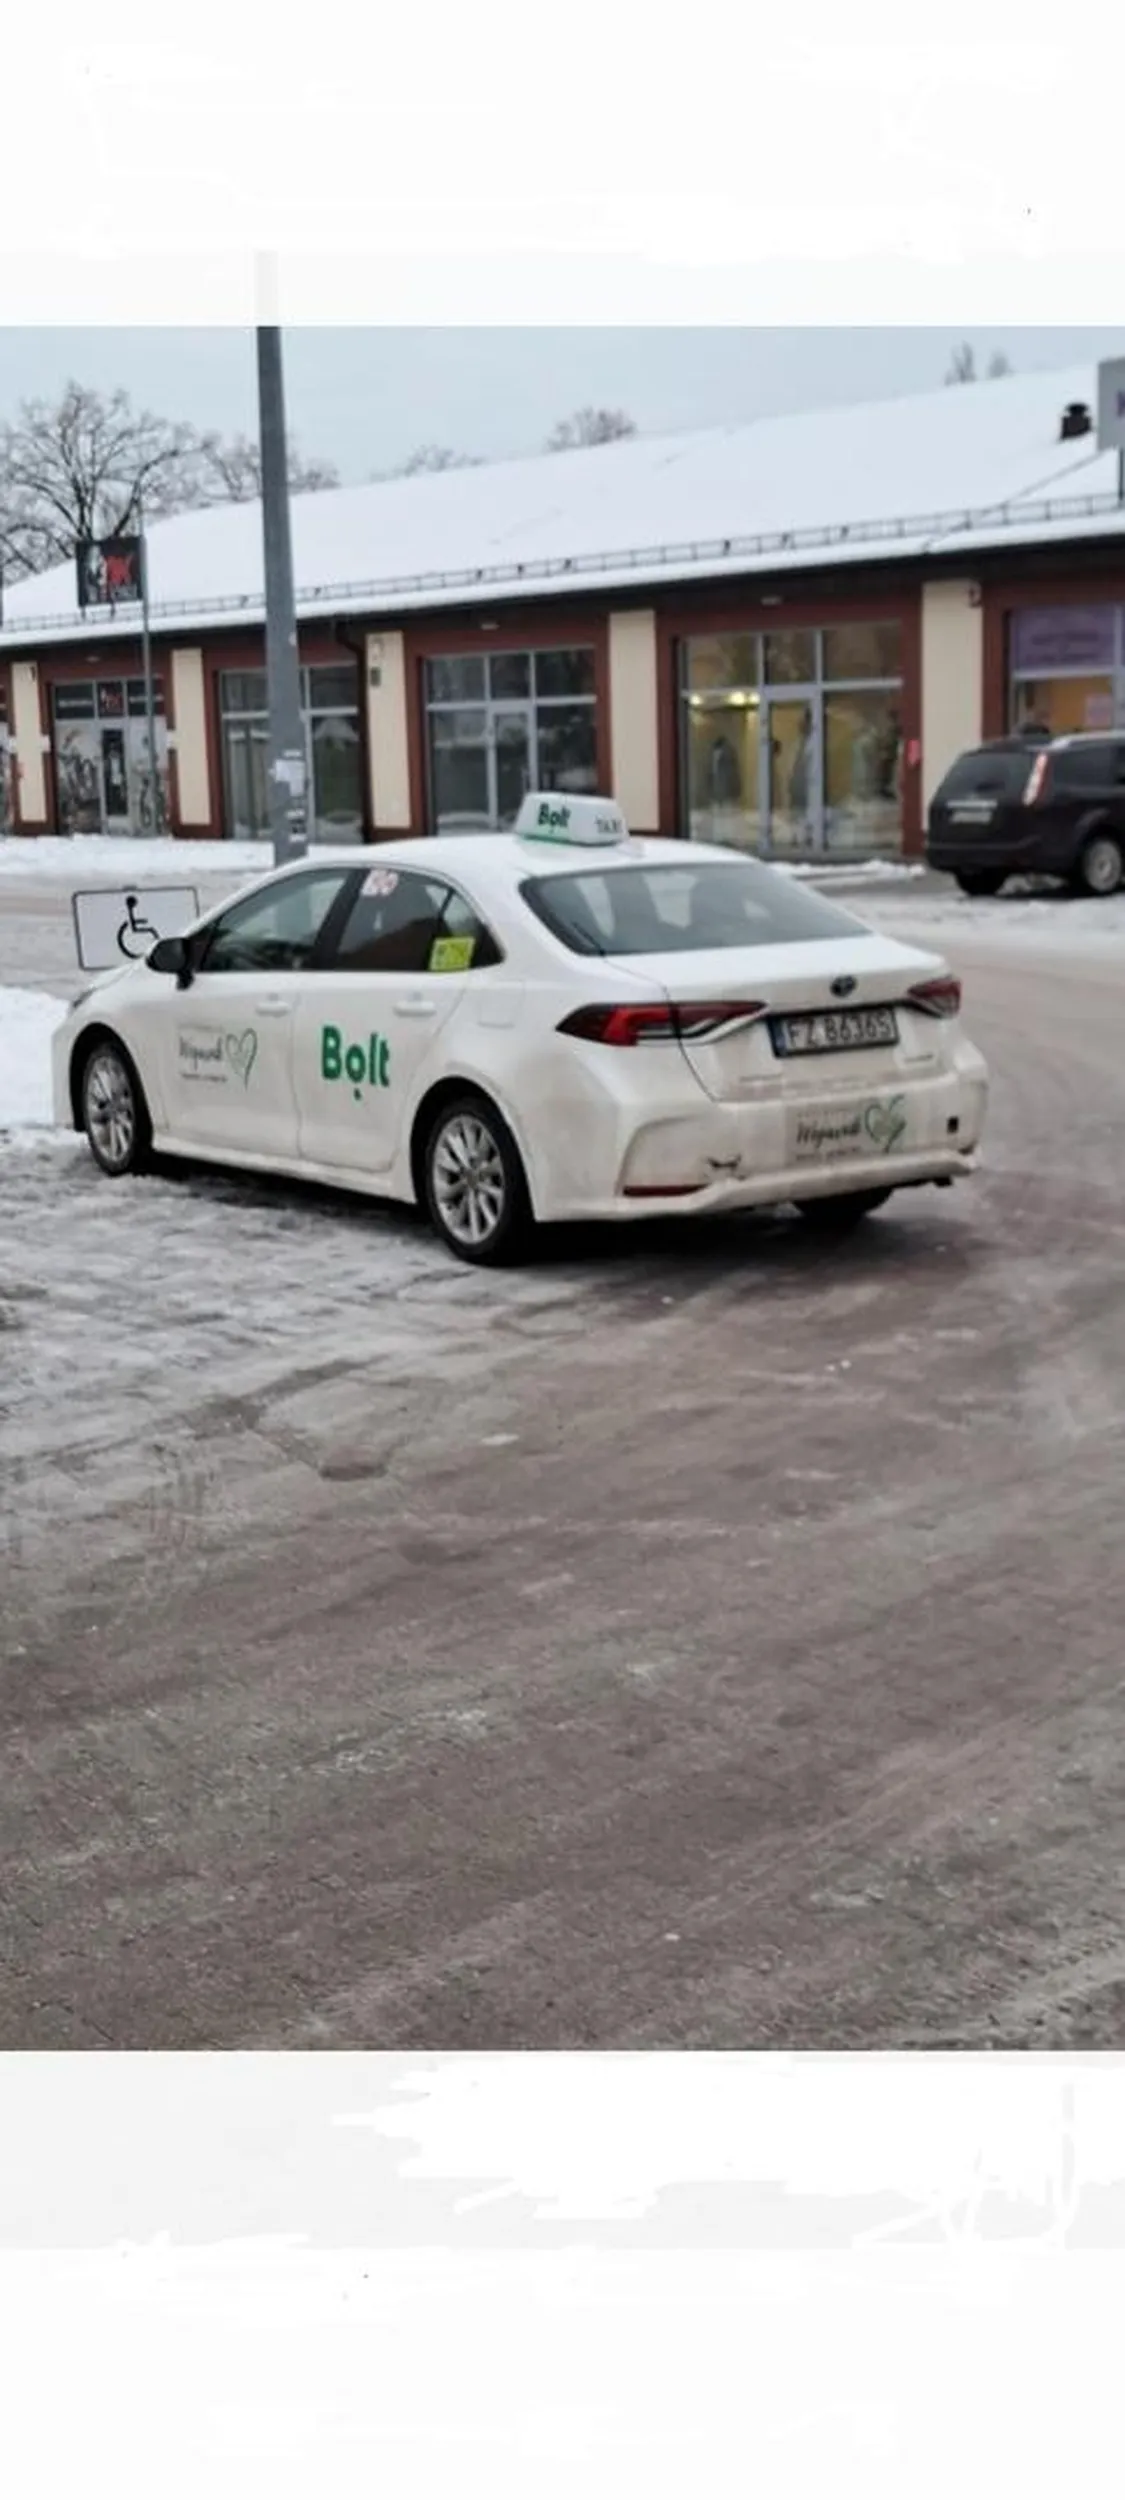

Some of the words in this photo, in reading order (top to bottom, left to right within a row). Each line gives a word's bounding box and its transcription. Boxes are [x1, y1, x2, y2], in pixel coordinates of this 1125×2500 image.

[538, 803, 571, 832] Bolt
[787, 1017, 817, 1048] FZ
[322, 1025, 390, 1100] Bolt
